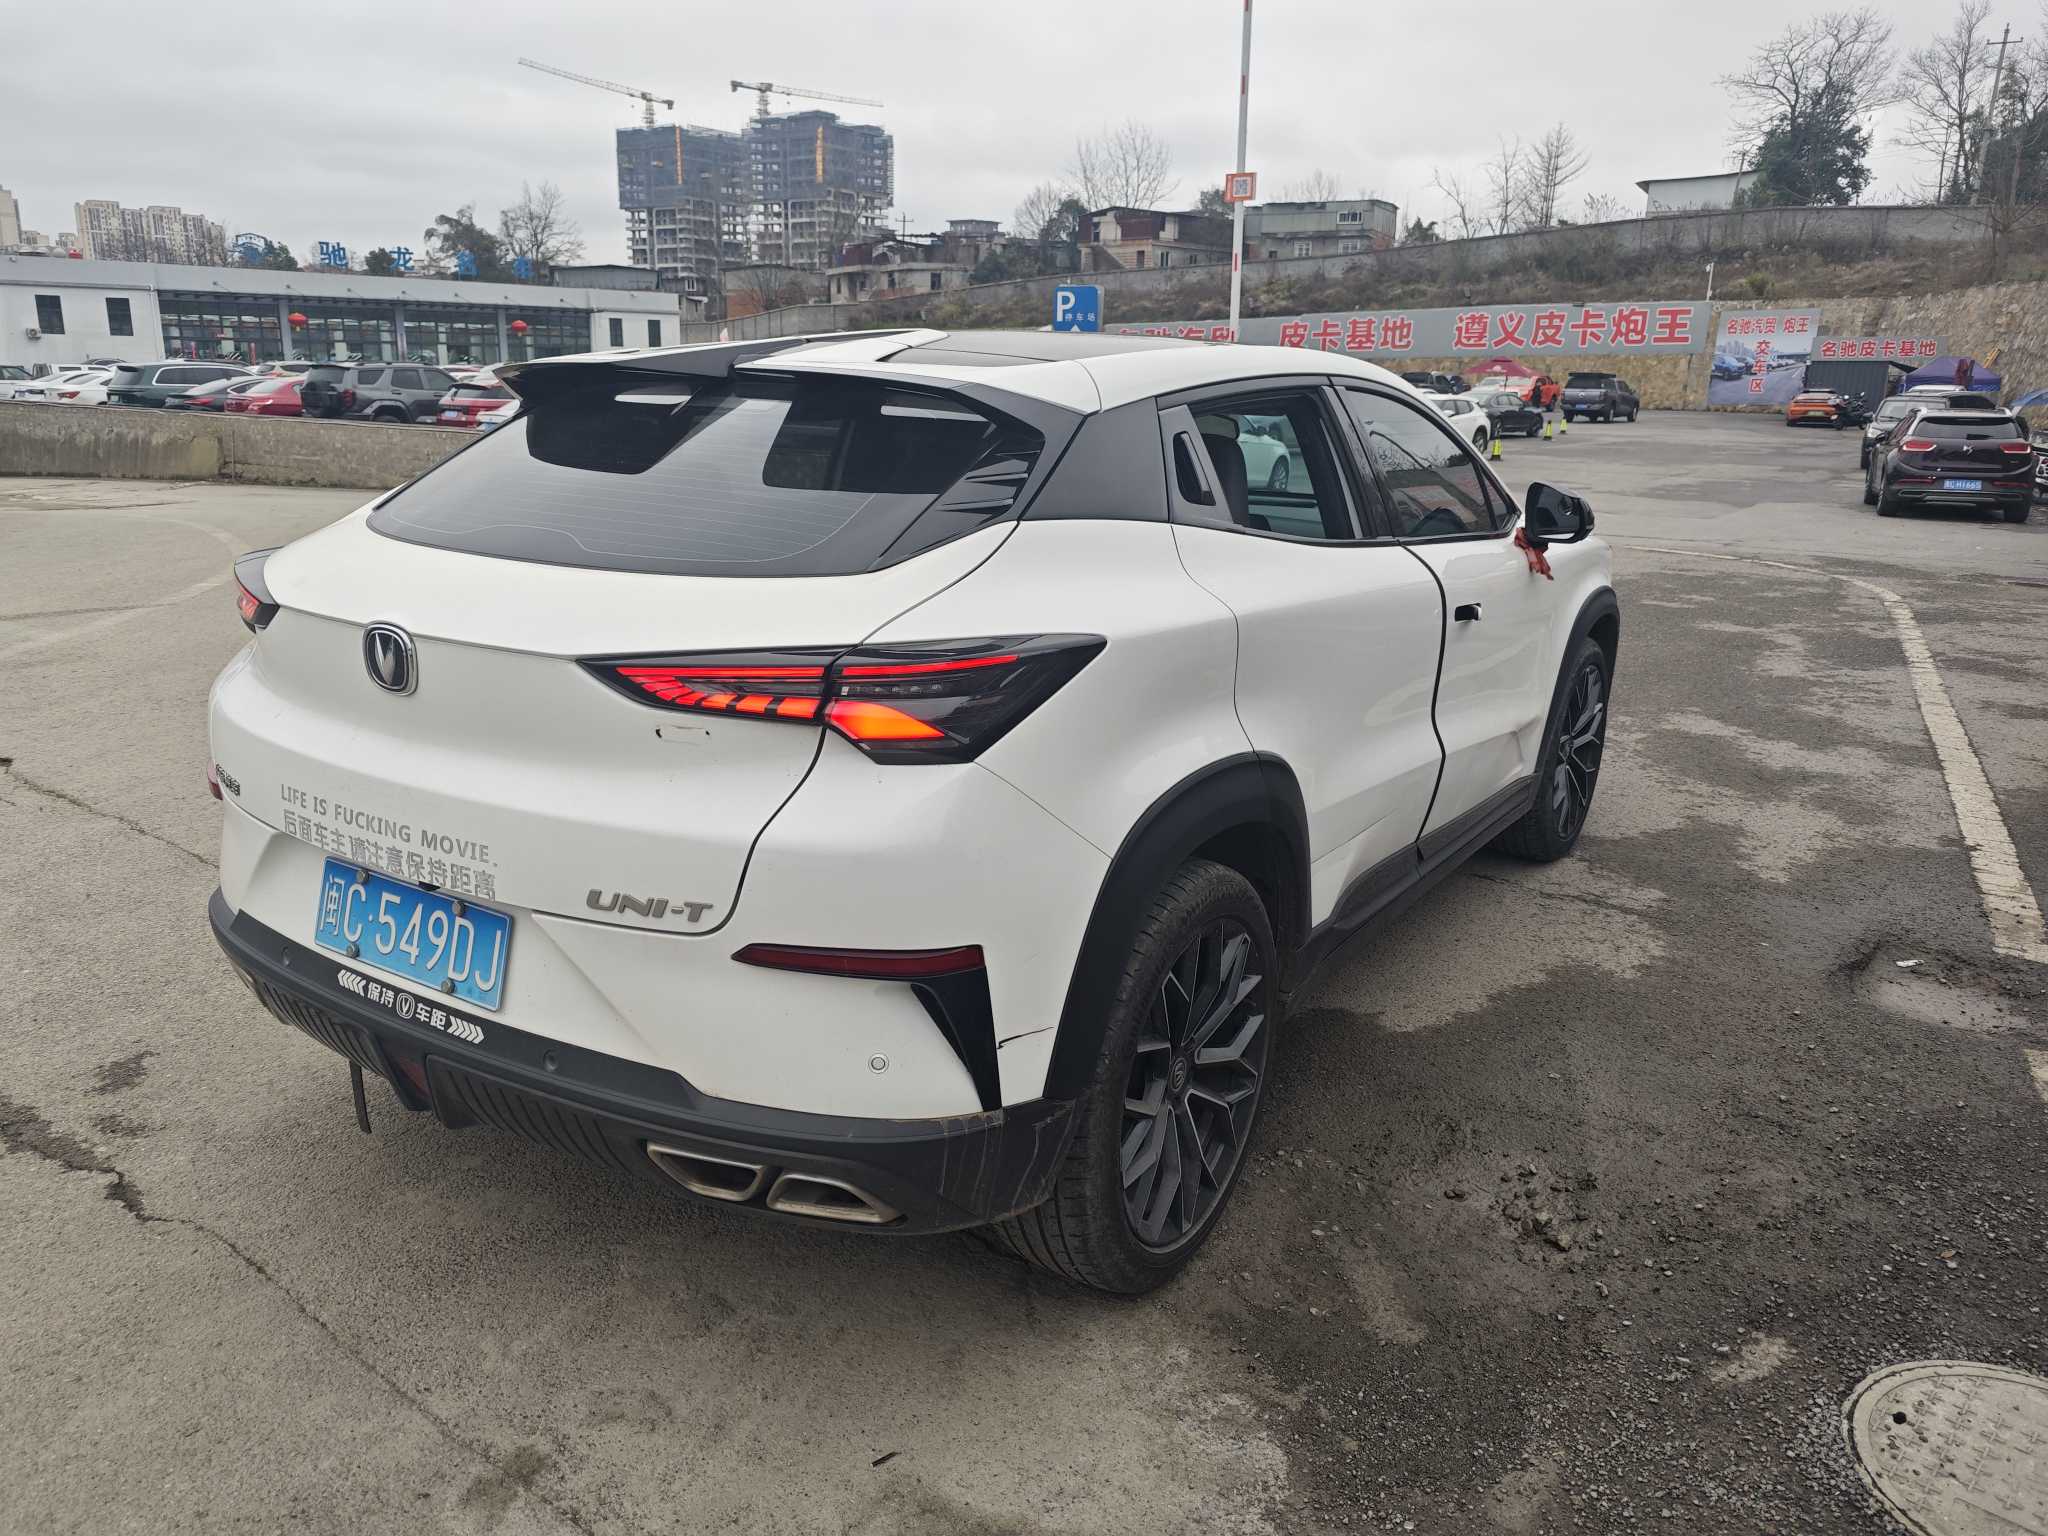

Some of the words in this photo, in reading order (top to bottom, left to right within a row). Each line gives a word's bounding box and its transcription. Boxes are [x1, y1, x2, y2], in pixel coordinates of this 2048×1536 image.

[1056, 291, 1076, 322] P
[1279, 315, 1413, 352] 皮卡基地
[1453, 305, 1693, 350] 遵义皮卡炮王
[1727, 317, 1777, 335] 名驰汽贸
[1783, 316, 1809, 334] 炮王
[1749, 339, 1771, 393] 交车区
[1821, 339, 1937, 358] 名驰皮卡基地
[281, 783, 307, 809] LIFE
[313, 796, 327, 816] IS
[334, 803, 411, 843] FUCKING
[283, 808, 496, 903] 后面车主请注意保持距离
[586, 888, 713, 923] UNI-T
[366, 981, 395, 1008] 保持
[415, 1002, 447, 1031] 车距
